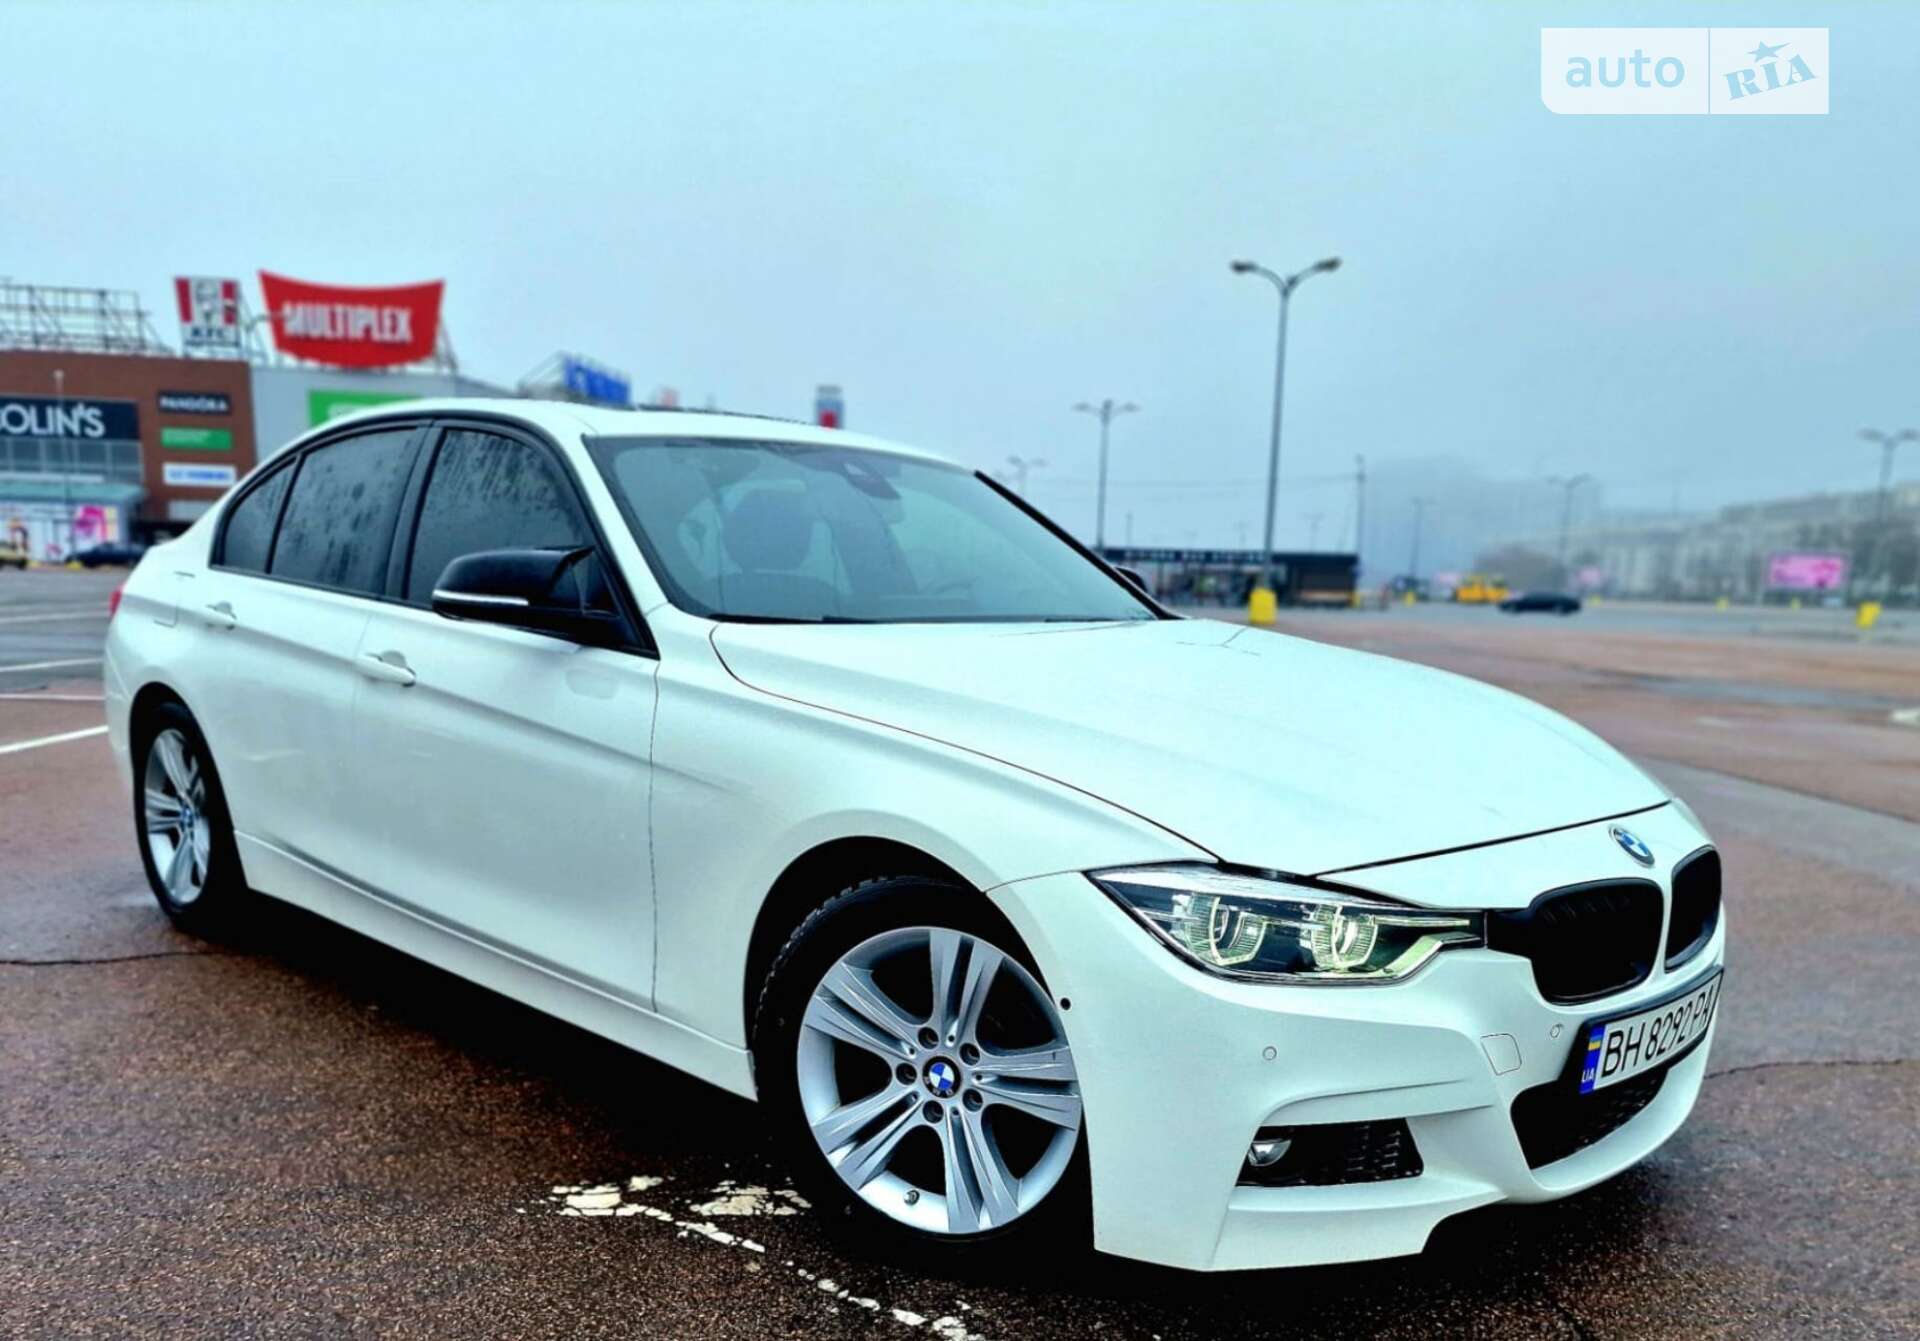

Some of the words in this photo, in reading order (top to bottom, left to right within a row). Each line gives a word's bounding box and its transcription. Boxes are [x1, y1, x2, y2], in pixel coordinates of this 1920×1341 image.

[282, 301, 413, 342] MULTIPLEX
[0, 402, 106, 438] OLIN'S
[1600, 1021, 1646, 1078] BH
[1644, 1001, 1694, 1061] 8292
[1692, 985, 1714, 1029] PA
